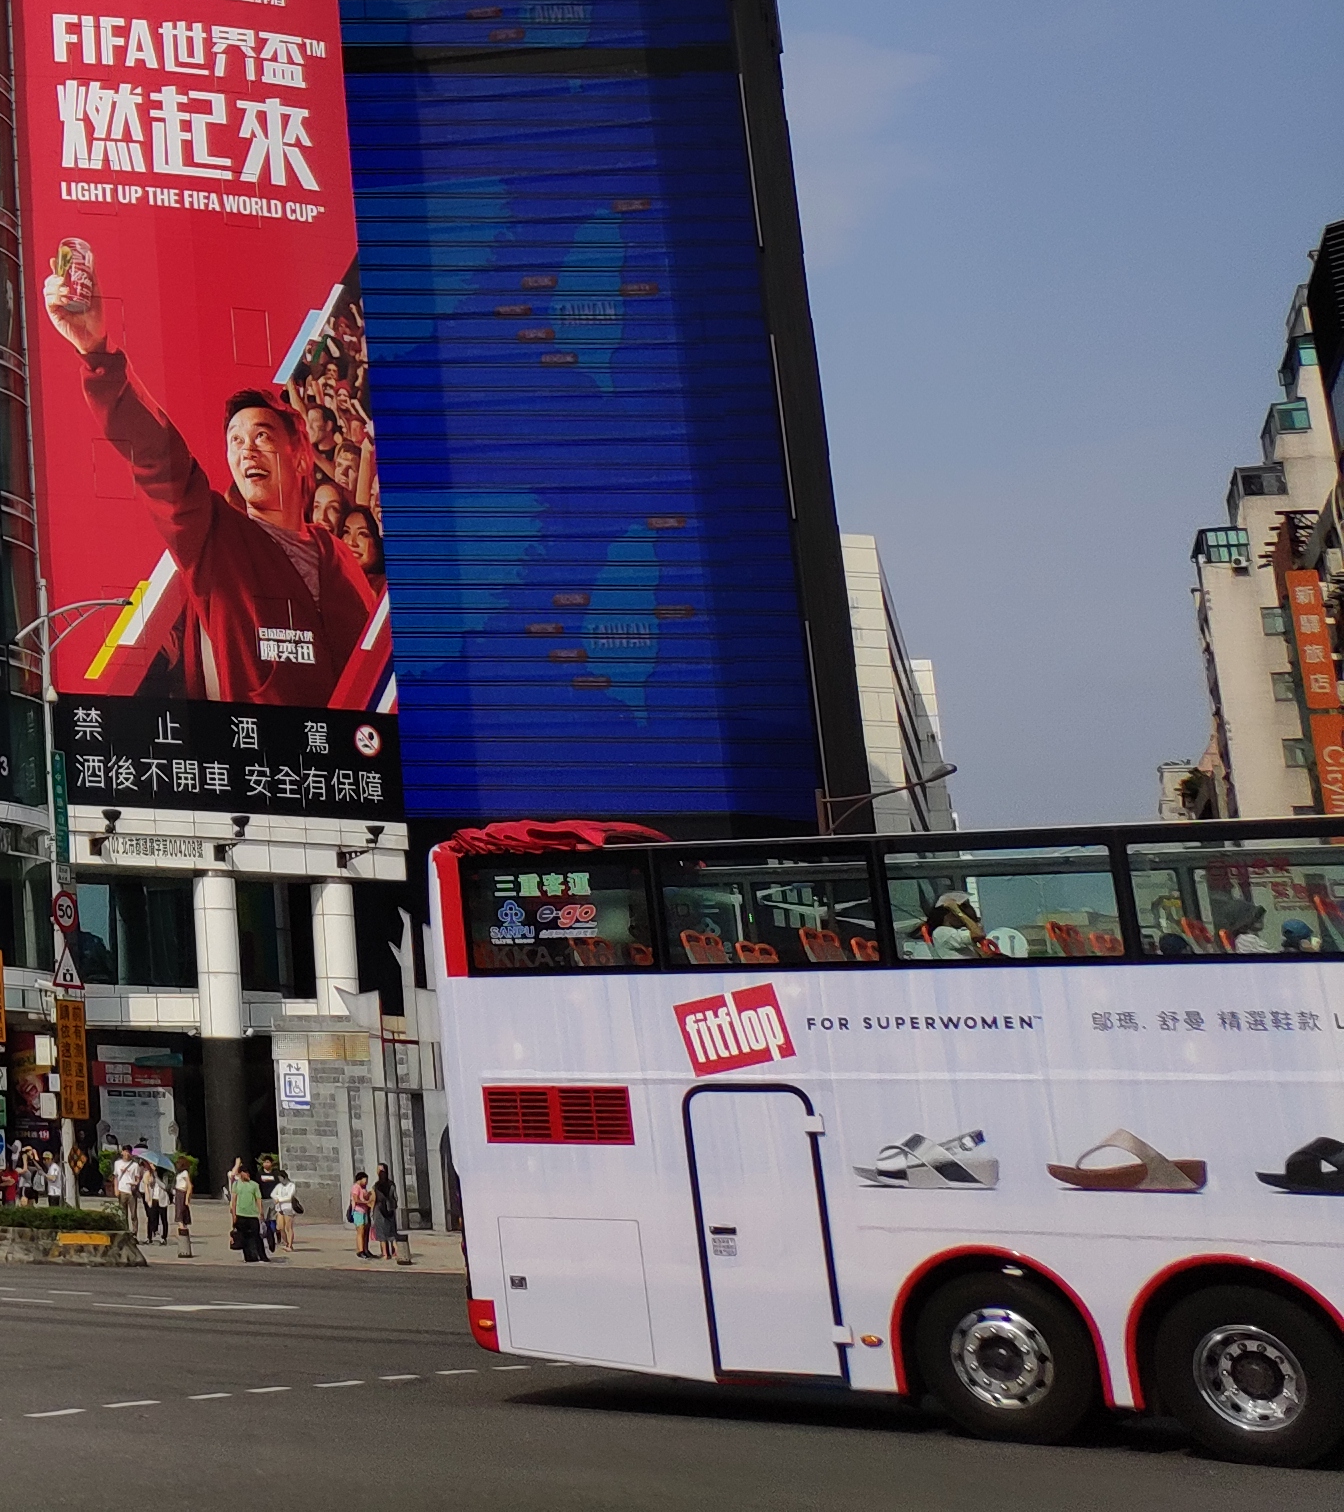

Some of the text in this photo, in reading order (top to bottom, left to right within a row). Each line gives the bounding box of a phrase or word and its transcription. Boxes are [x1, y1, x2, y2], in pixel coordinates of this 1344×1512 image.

[55, 79, 321, 192] 燃起來
[60, 180, 114, 204] LIGHT
[116, 185, 142, 205] UP
[144, 186, 181, 208] THE
[183, 190, 220, 212] FIFA
[222, 193, 283, 219] WORLD
[260, 640, 315, 664] 陳奕迅
[75, 754, 384, 804] 酒後不開車 安全有保障
[494, 872, 592, 896] 三重客運
[57, 902, 74, 919] 50
[536, 904, 597, 928] e-go
[490, 925, 536, 938] SANPU
[685, 992, 786, 1062] fitflop
[806, 1017, 850, 1031] FOR
[1217, 1010, 1323, 1032] 精選鞋款
